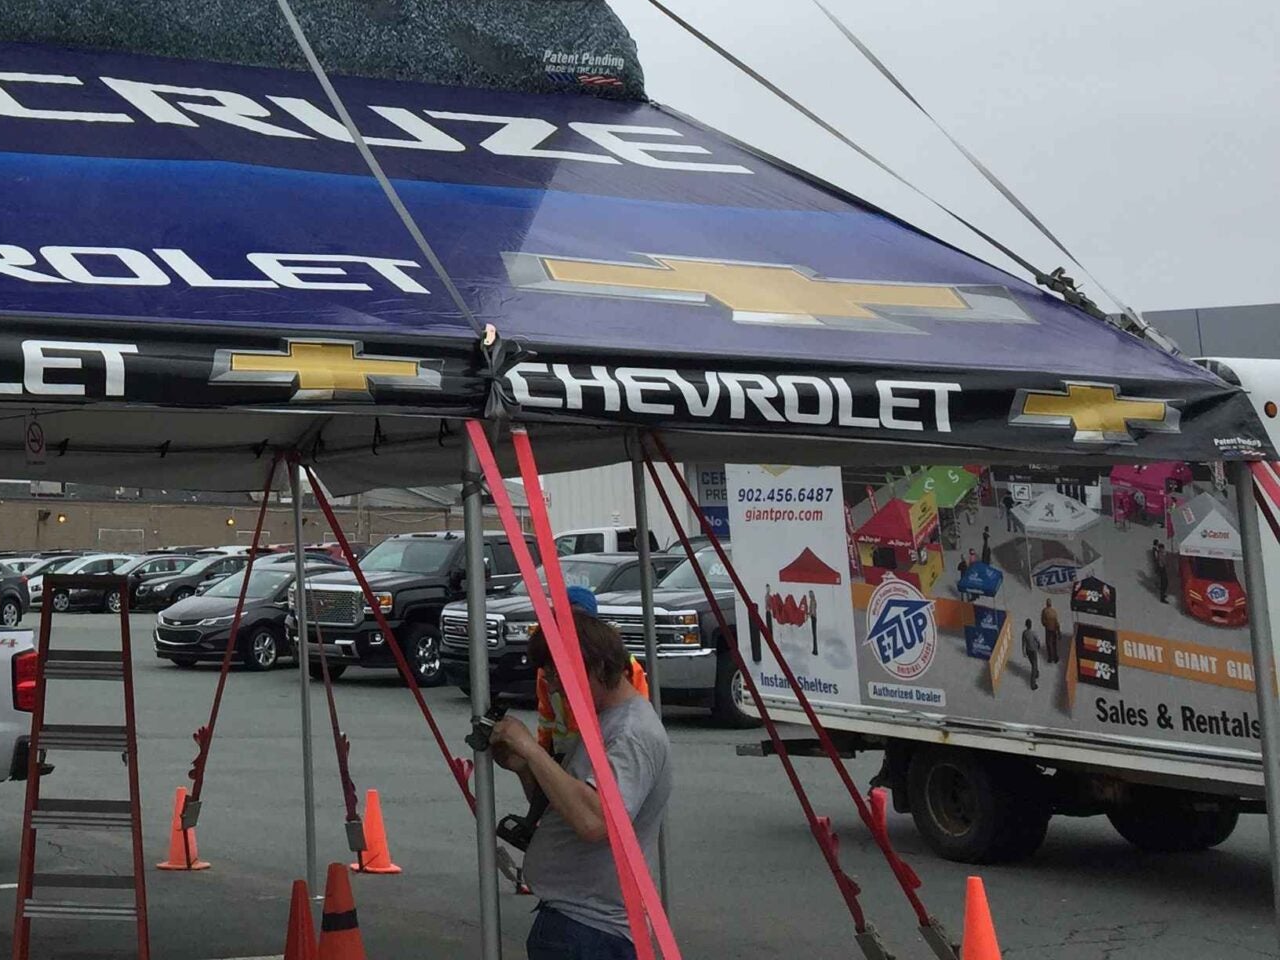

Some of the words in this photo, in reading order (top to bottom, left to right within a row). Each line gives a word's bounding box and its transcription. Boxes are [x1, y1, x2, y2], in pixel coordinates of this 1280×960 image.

[543, 50, 579, 65] Patent
[582, 52, 625, 70] Pending
[545, 64, 566, 73] MADE
[508, 362, 962, 433] CHEVROLET
[738, 488, 833, 503] 902.456.6487
[745, 507, 823, 523] giantpro.com
[1123, 640, 1163, 664] GIANT
[1175, 651, 1218, 675] GIANT
[760, 672, 792, 689] Instan
[798, 675, 839, 695] Shelters
[873, 685, 913, 700] Authorized
[916, 689, 943, 703] Dealer
[1096, 697, 1149, 727] Sales
[1157, 703, 1173, 730] &
[1181, 705, 1261, 739] Rentals
